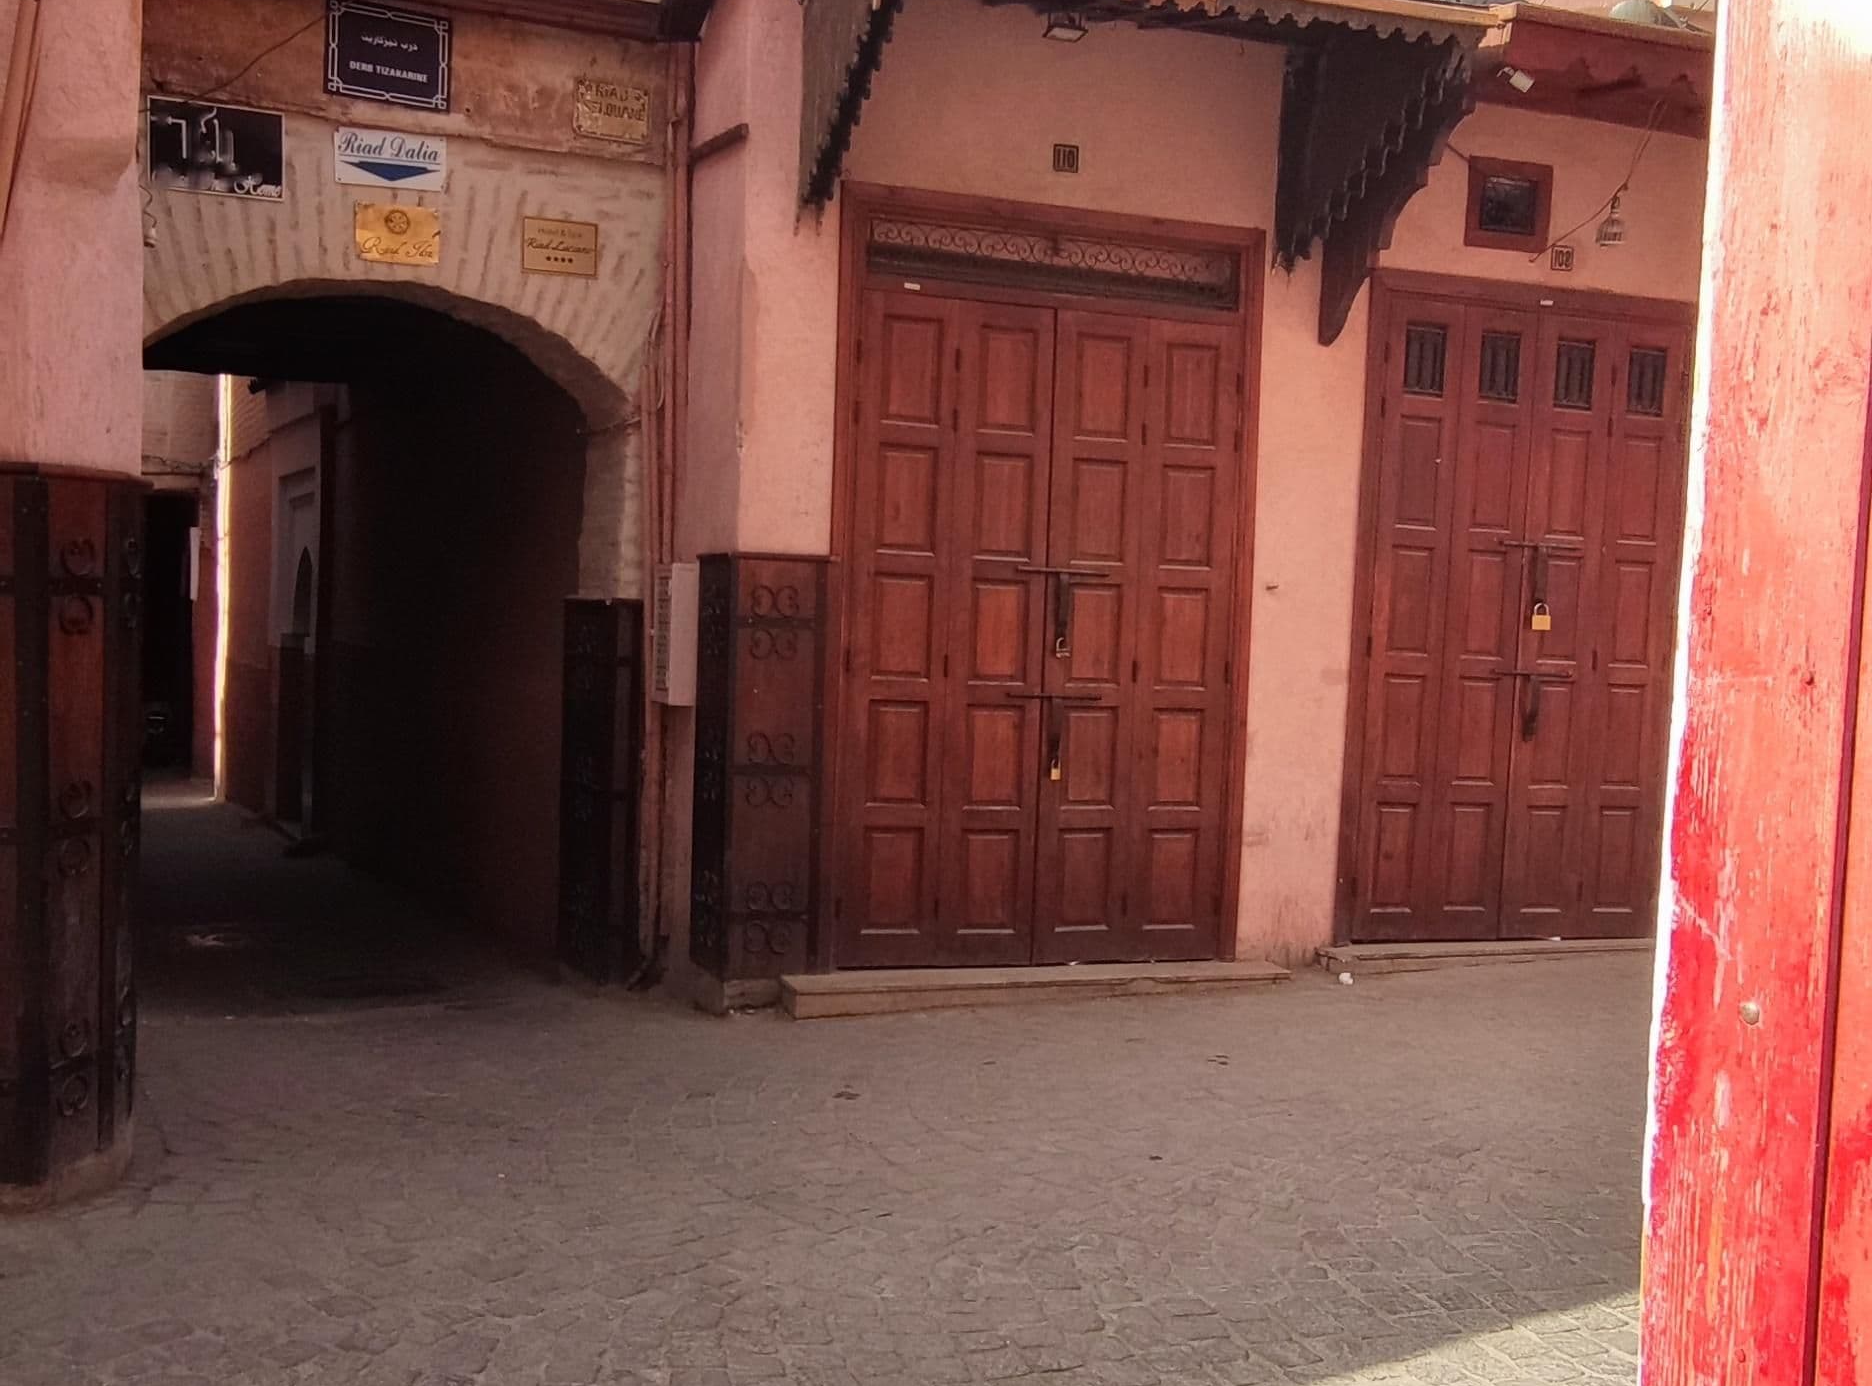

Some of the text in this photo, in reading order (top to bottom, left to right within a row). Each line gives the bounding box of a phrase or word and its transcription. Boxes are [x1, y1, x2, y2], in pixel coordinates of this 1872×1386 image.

[348, 59, 374, 73] DERB
[337, 132, 439, 161] Riad Dalia
